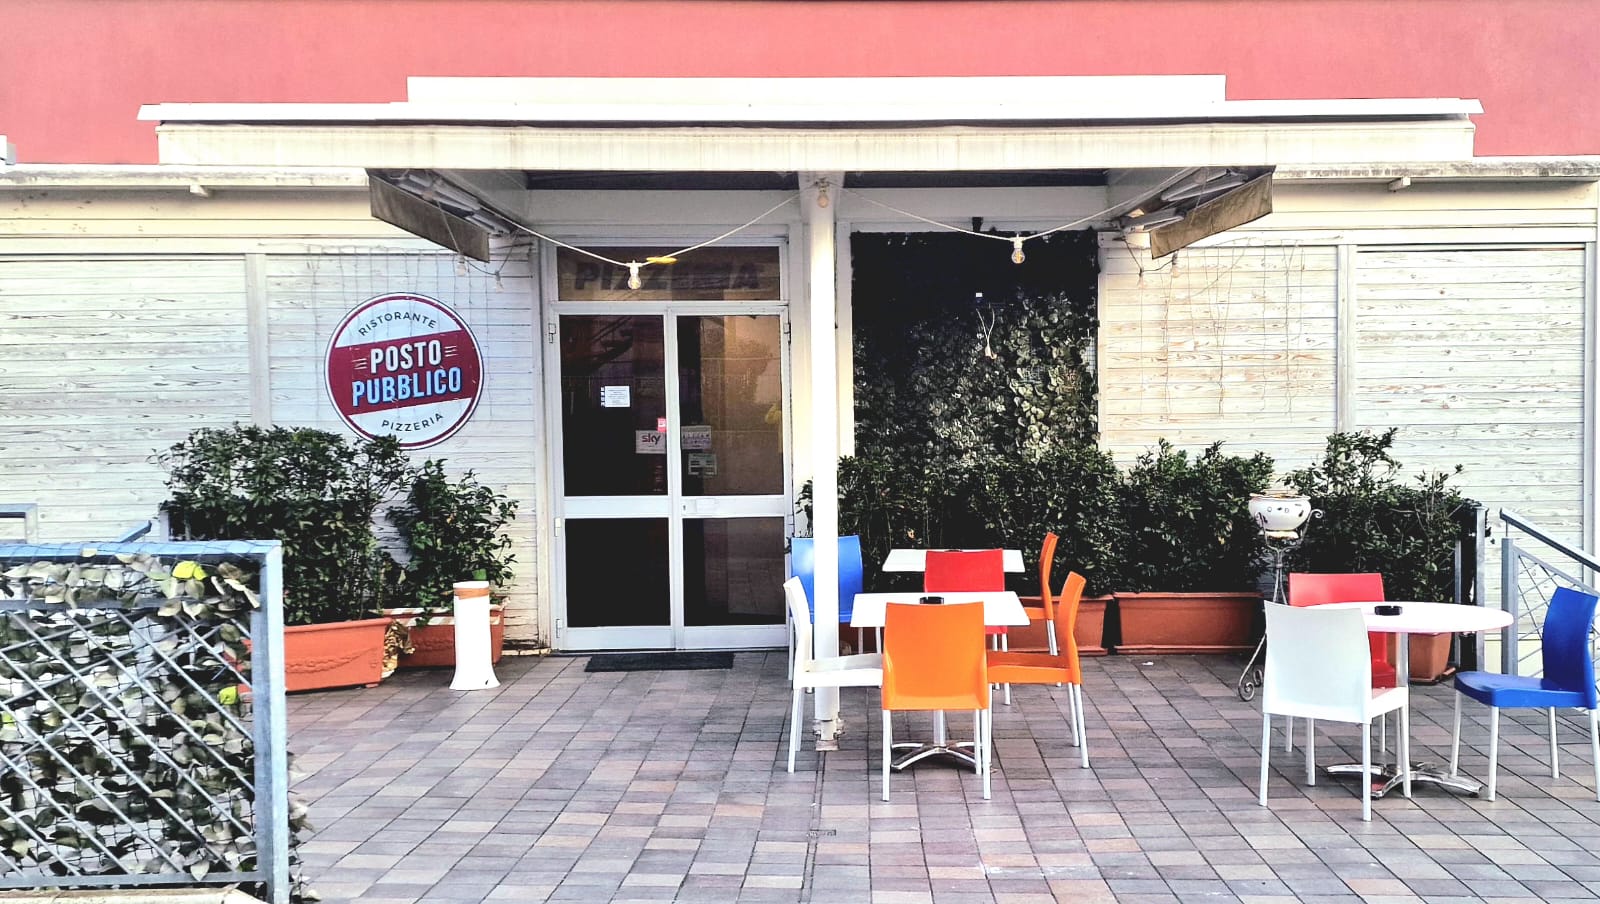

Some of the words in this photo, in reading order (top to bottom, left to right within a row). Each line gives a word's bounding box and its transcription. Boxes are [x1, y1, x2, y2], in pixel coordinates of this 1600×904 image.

[358, 311, 437, 337] RISTORANTE
[370, 339, 442, 374] POSTO
[351, 366, 463, 407] PUBBLICO
[381, 413, 444, 432] PIZZERIA
[641, 433, 661, 445] sky
